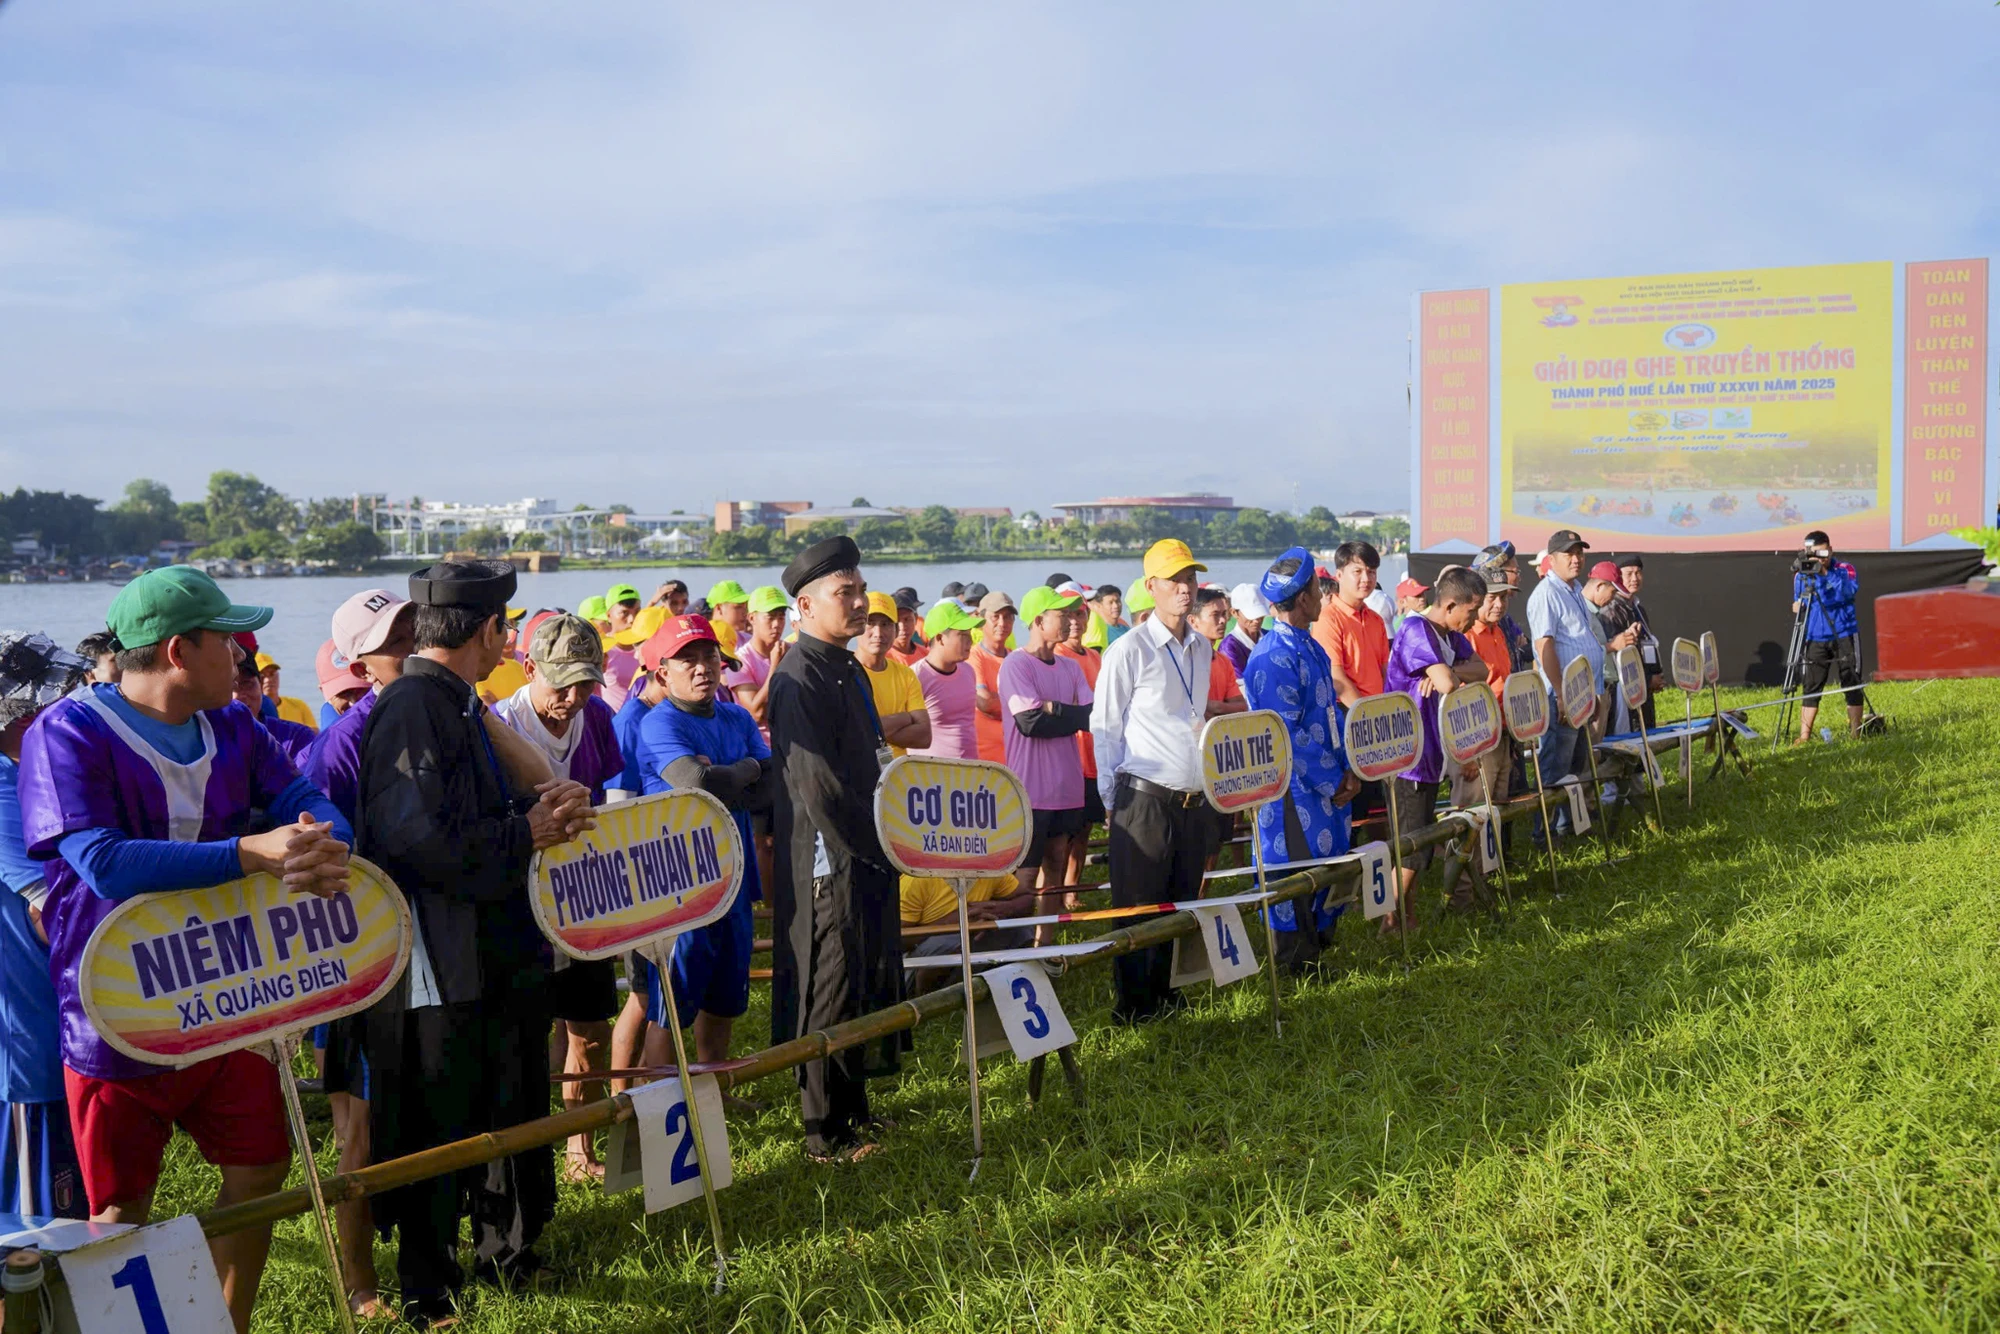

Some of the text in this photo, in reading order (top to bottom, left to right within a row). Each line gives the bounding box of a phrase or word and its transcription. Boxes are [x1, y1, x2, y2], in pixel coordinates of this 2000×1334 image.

[1920, 266, 1971, 285] TOÀN
[1926, 289, 1965, 307] DÂN
[1929, 312, 1967, 329] RÈN
[1915, 333, 1974, 353] LUYỆN
[1534, 353, 1577, 383] GIẢI
[1634, 355, 1677, 379] GHE
[1682, 344, 1771, 377] TRUYỀN
[1776, 341, 1856, 374] THỐNG
[1920, 355, 1970, 374] THÂN
[1551, 377, 1836, 400] THÀNH PHỐ HUẾ LẦN THỨ XXXVI NĂM 2025
[1921, 402, 1967, 418] THEO
[1911, 423, 1976, 440] GƯƠNG
[1375, 712, 1392, 743] SƠN
[1392, 706, 1413, 740] ĐÔNG
[1213, 727, 1275, 775] VÂN THÊ
[1355, 749, 1384, 767] PHƯỜNG
[1398, 738, 1414, 757] CHÂU
[1213, 775, 1242, 797] PHƯỜNG
[1242, 770, 1262, 790] THANH
[907, 784, 998, 830] CƠ GIỚI
[923, 830, 938, 852] XÃ
[940, 835, 962, 853] ĐAN
[549, 825, 723, 928] PHƯỜNG THUẬN AN
[1372, 858, 1386, 905] 5
[131, 915, 263, 1000] NIÊM
[1214, 914, 1240, 967] 4
[177, 958, 349, 1029] XÃ QUẢNG ĐIỀN
[1011, 976, 1050, 1039] 3
[665, 1100, 701, 1186] 2
[111, 1254, 170, 1334] 1
